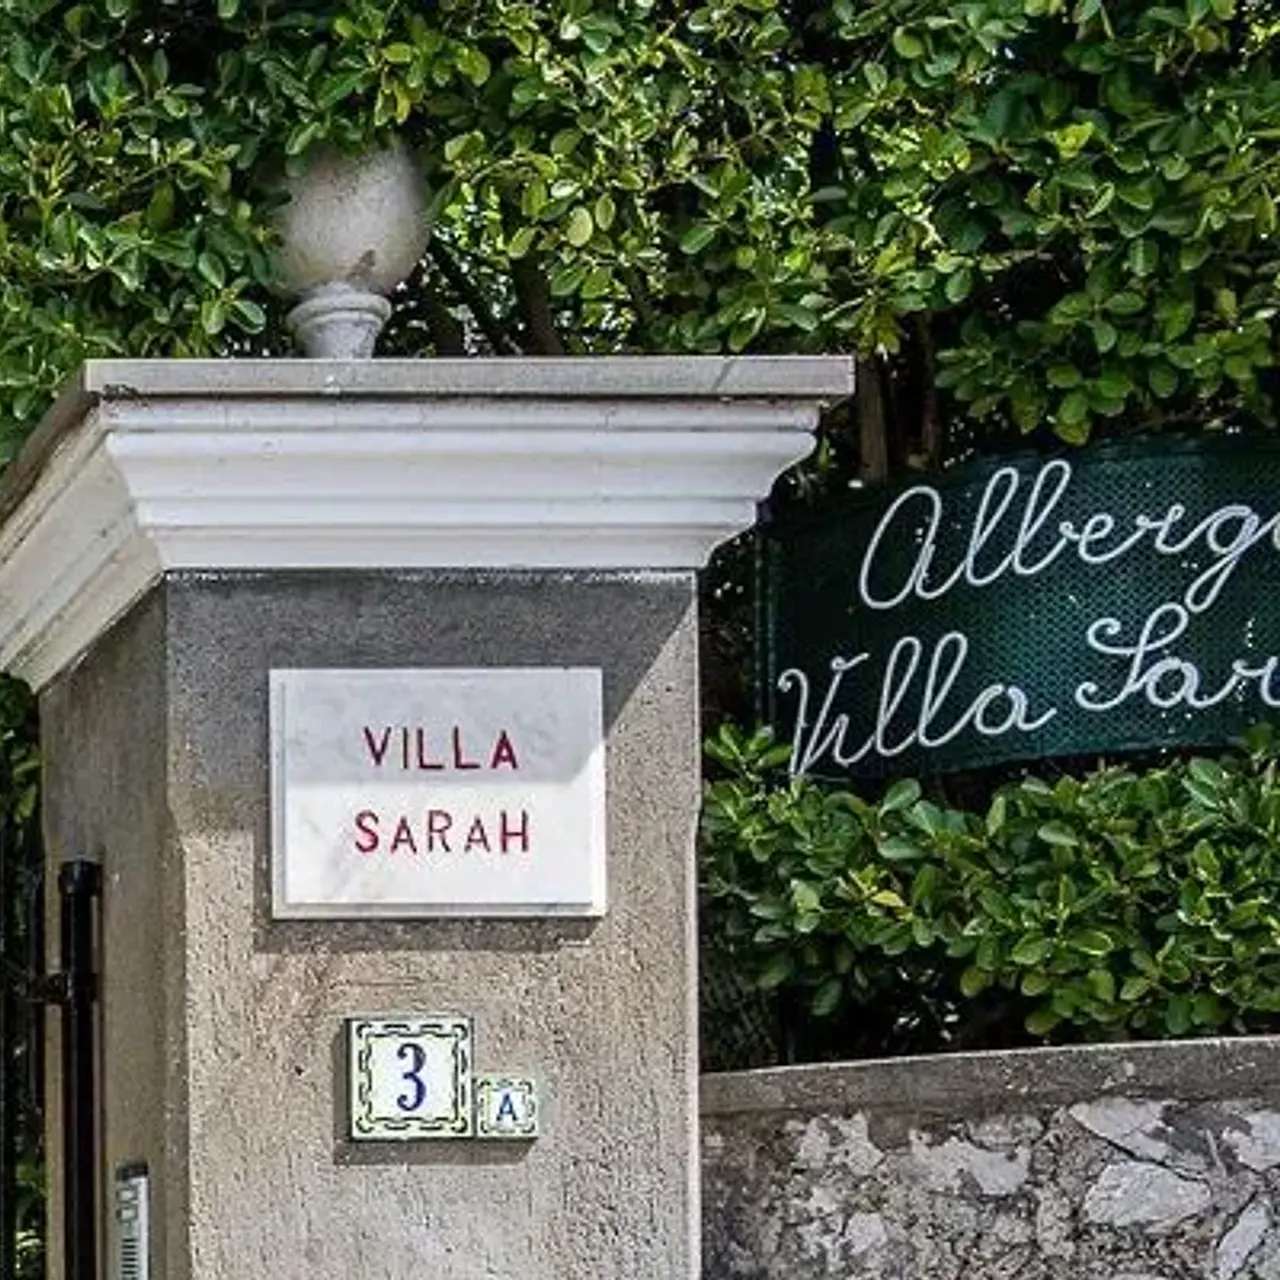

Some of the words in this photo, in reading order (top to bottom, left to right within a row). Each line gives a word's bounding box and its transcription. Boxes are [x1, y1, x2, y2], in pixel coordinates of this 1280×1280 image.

[859, 459, 1280, 613] Alberg
[777, 630, 1058, 777] Villa
[363, 725, 519, 769] VILLA
[354, 809, 529, 854] SARAH
[396, 1042, 427, 1112] 3
[496, 1092, 519, 1122] A
